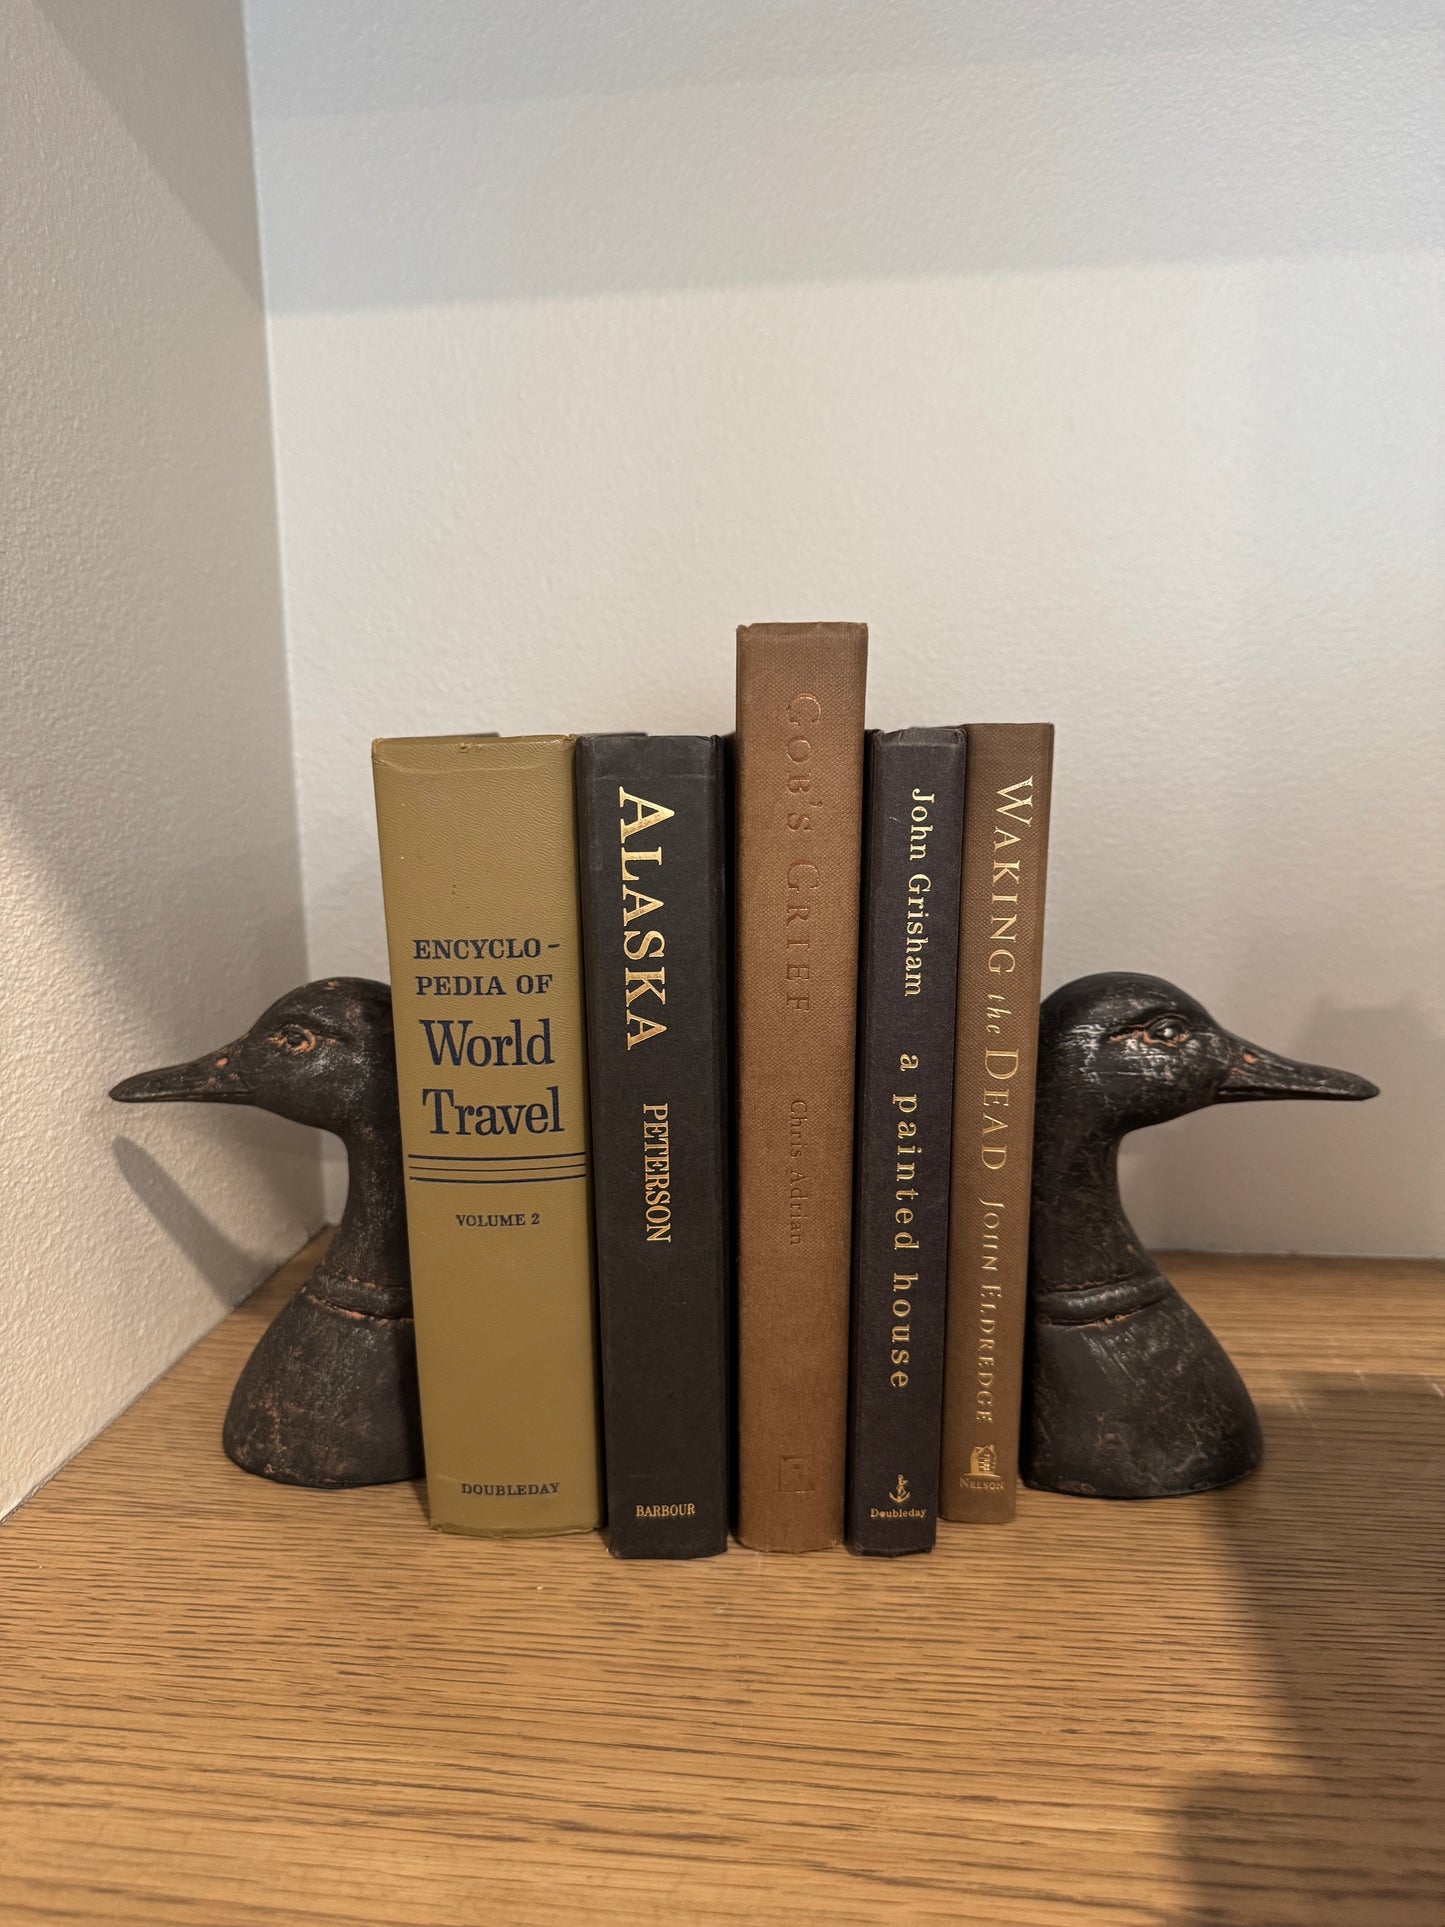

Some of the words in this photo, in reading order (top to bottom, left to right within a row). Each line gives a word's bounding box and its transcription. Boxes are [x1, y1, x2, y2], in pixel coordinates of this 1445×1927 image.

[909, 788, 935, 861] John
[987, 775, 1034, 976] WAKING
[618, 786, 675, 1050] ALASKA
[785, 860, 819, 1012] GRIEF
[904, 873, 931, 997] Grisham
[415, 975, 506, 996] PEDIA
[516, 974, 553, 995] OF
[986, 992, 1007, 1034] the
[419, 1018, 555, 1067] World
[900, 1053, 920, 1072] a
[422, 1085, 565, 1137] Travel
[790, 1099, 808, 1159] Chris
[981, 1048, 1019, 1170] DEAD
[642, 1102, 671, 1243] PETERSON
[789, 1171, 808, 1246] Adrian
[892, 1094, 922, 1250] painted
[456, 1213, 525, 1227] VOLUME
[531, 1212, 541, 1225] 2
[978, 1197, 1005, 1271] JOHN
[890, 1272, 919, 1388] house
[976, 1284, 1002, 1424] ELDREDGE
[461, 1482, 560, 1496] DOUBLEDAY
[635, 1503, 695, 1518] BARBOUR
[870, 1507, 926, 1519] Doubleday
[960, 1477, 1004, 1491] NELSON
